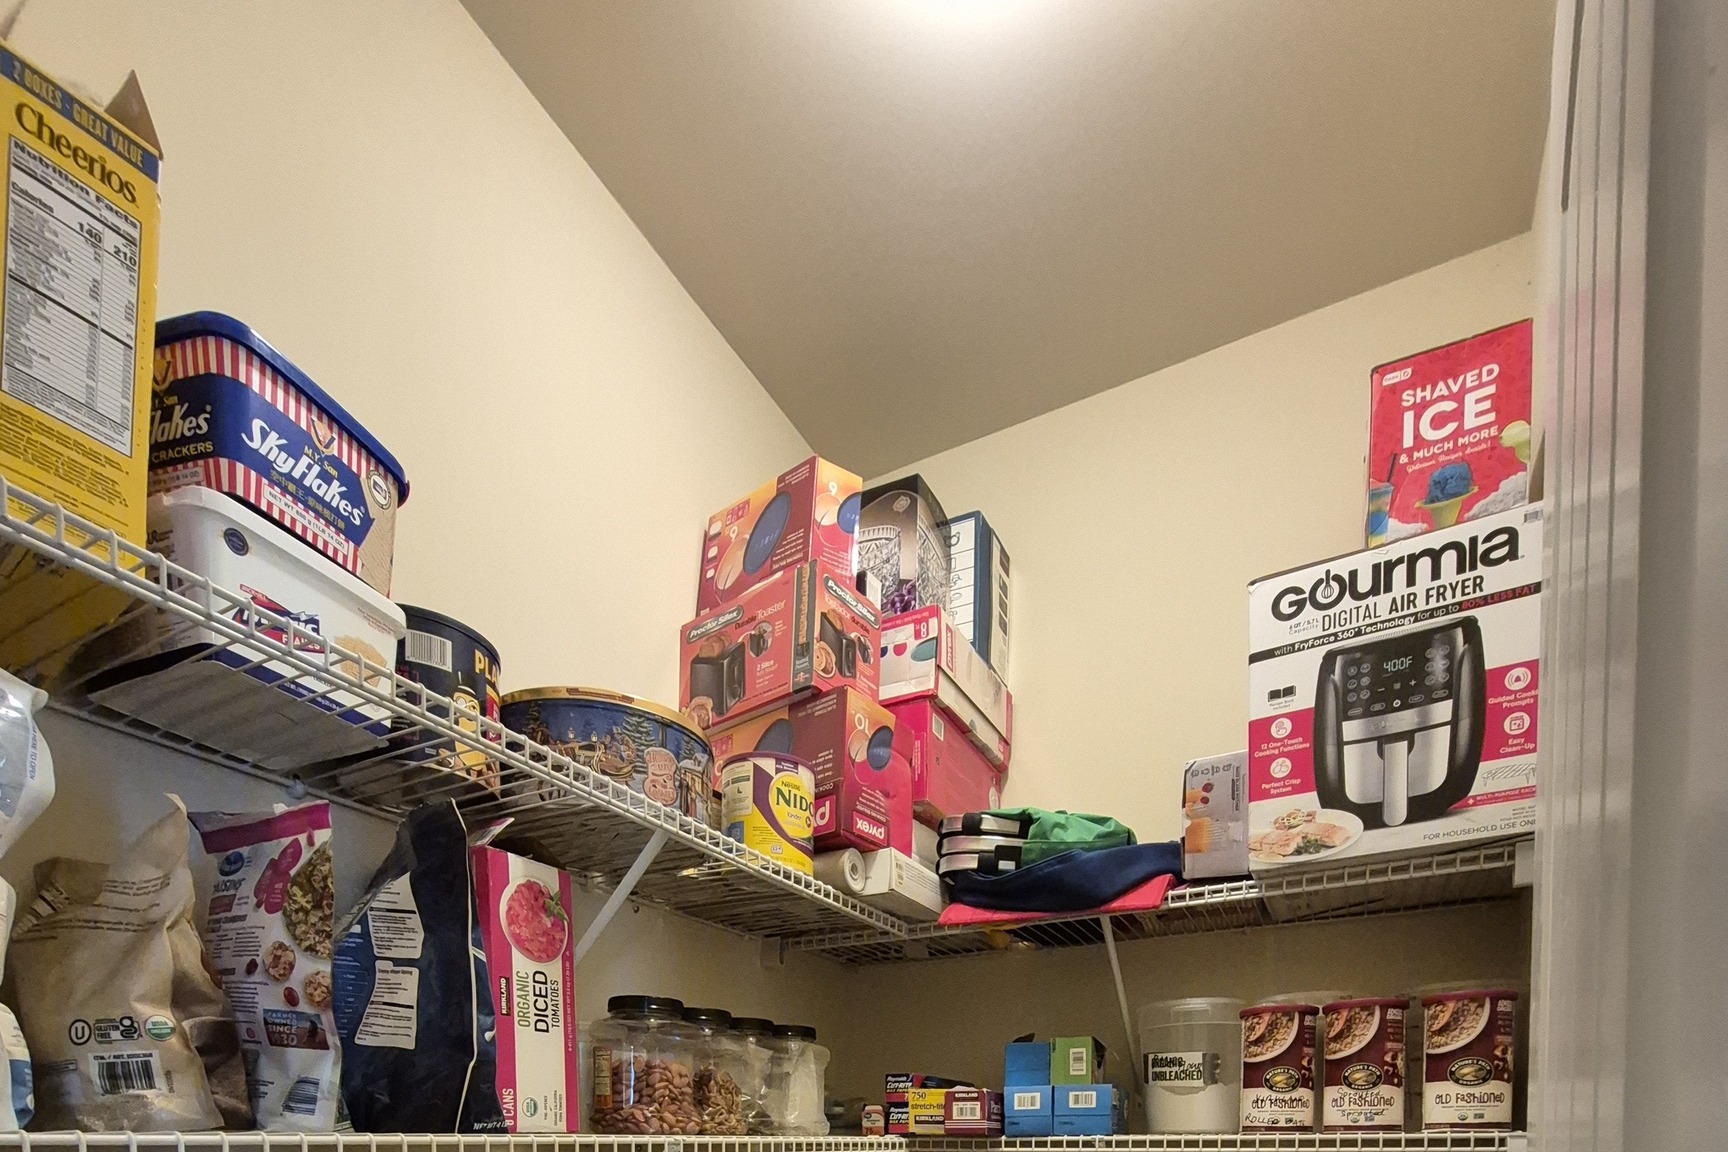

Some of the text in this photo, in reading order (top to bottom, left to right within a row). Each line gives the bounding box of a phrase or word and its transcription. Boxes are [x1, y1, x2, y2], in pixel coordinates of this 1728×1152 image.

[24, 66, 62, 108] BOXES
[73, 100, 108, 140] GREAT
[111, 133, 144, 167] VALUE
[14, 142, 90, 196] Nutrition
[15, 102, 137, 203] Cheerios
[77, 222, 137, 267] 140 210
[1401, 364, 1499, 407] SHAVED
[1403, 383, 1497, 449] ICE
[151, 441, 214, 463] CRACKERS
[1399, 425, 1499, 464] & MUCH MORE
[241, 418, 366, 527] SkyFlakes
[1271, 526, 1520, 622] Gourmia
[756, 600, 786, 620] Toaster
[1274, 643, 1293, 656] with
[1294, 634, 1335, 652] FryForce
[1360, 616, 1416, 635] Technology
[1417, 611, 1432, 622] for
[1433, 608, 1447, 619] up
[1448, 603, 1460, 613] to
[1488, 591, 1513, 604] LESS
[1515, 585, 1536, 598] FAT
[1322, 575, 1484, 632] DIGITAL AIR FRYER
[475, 649, 500, 686] PLA
[1383, 656, 1413, 672] 400F
[855, 713, 870, 734] 10
[855, 817, 885, 840] pyrex
[1423, 820, 1517, 841] FOR HOUSEHOLD USE
[500, 978, 508, 1015] KIRKLAND
[515, 970, 531, 1028] ORGANIC
[532, 970, 550, 1034] DICED
[550, 979, 561, 1029] TOMATOES
[268, 1025, 297, 1034] SINCE
[1152, 1070, 1202, 1081] UNBLEACHED
[503, 1088, 515, 1117] CANS
[911, 1091, 926, 1100] 750
[1435, 1093, 1451, 1105] OLD
